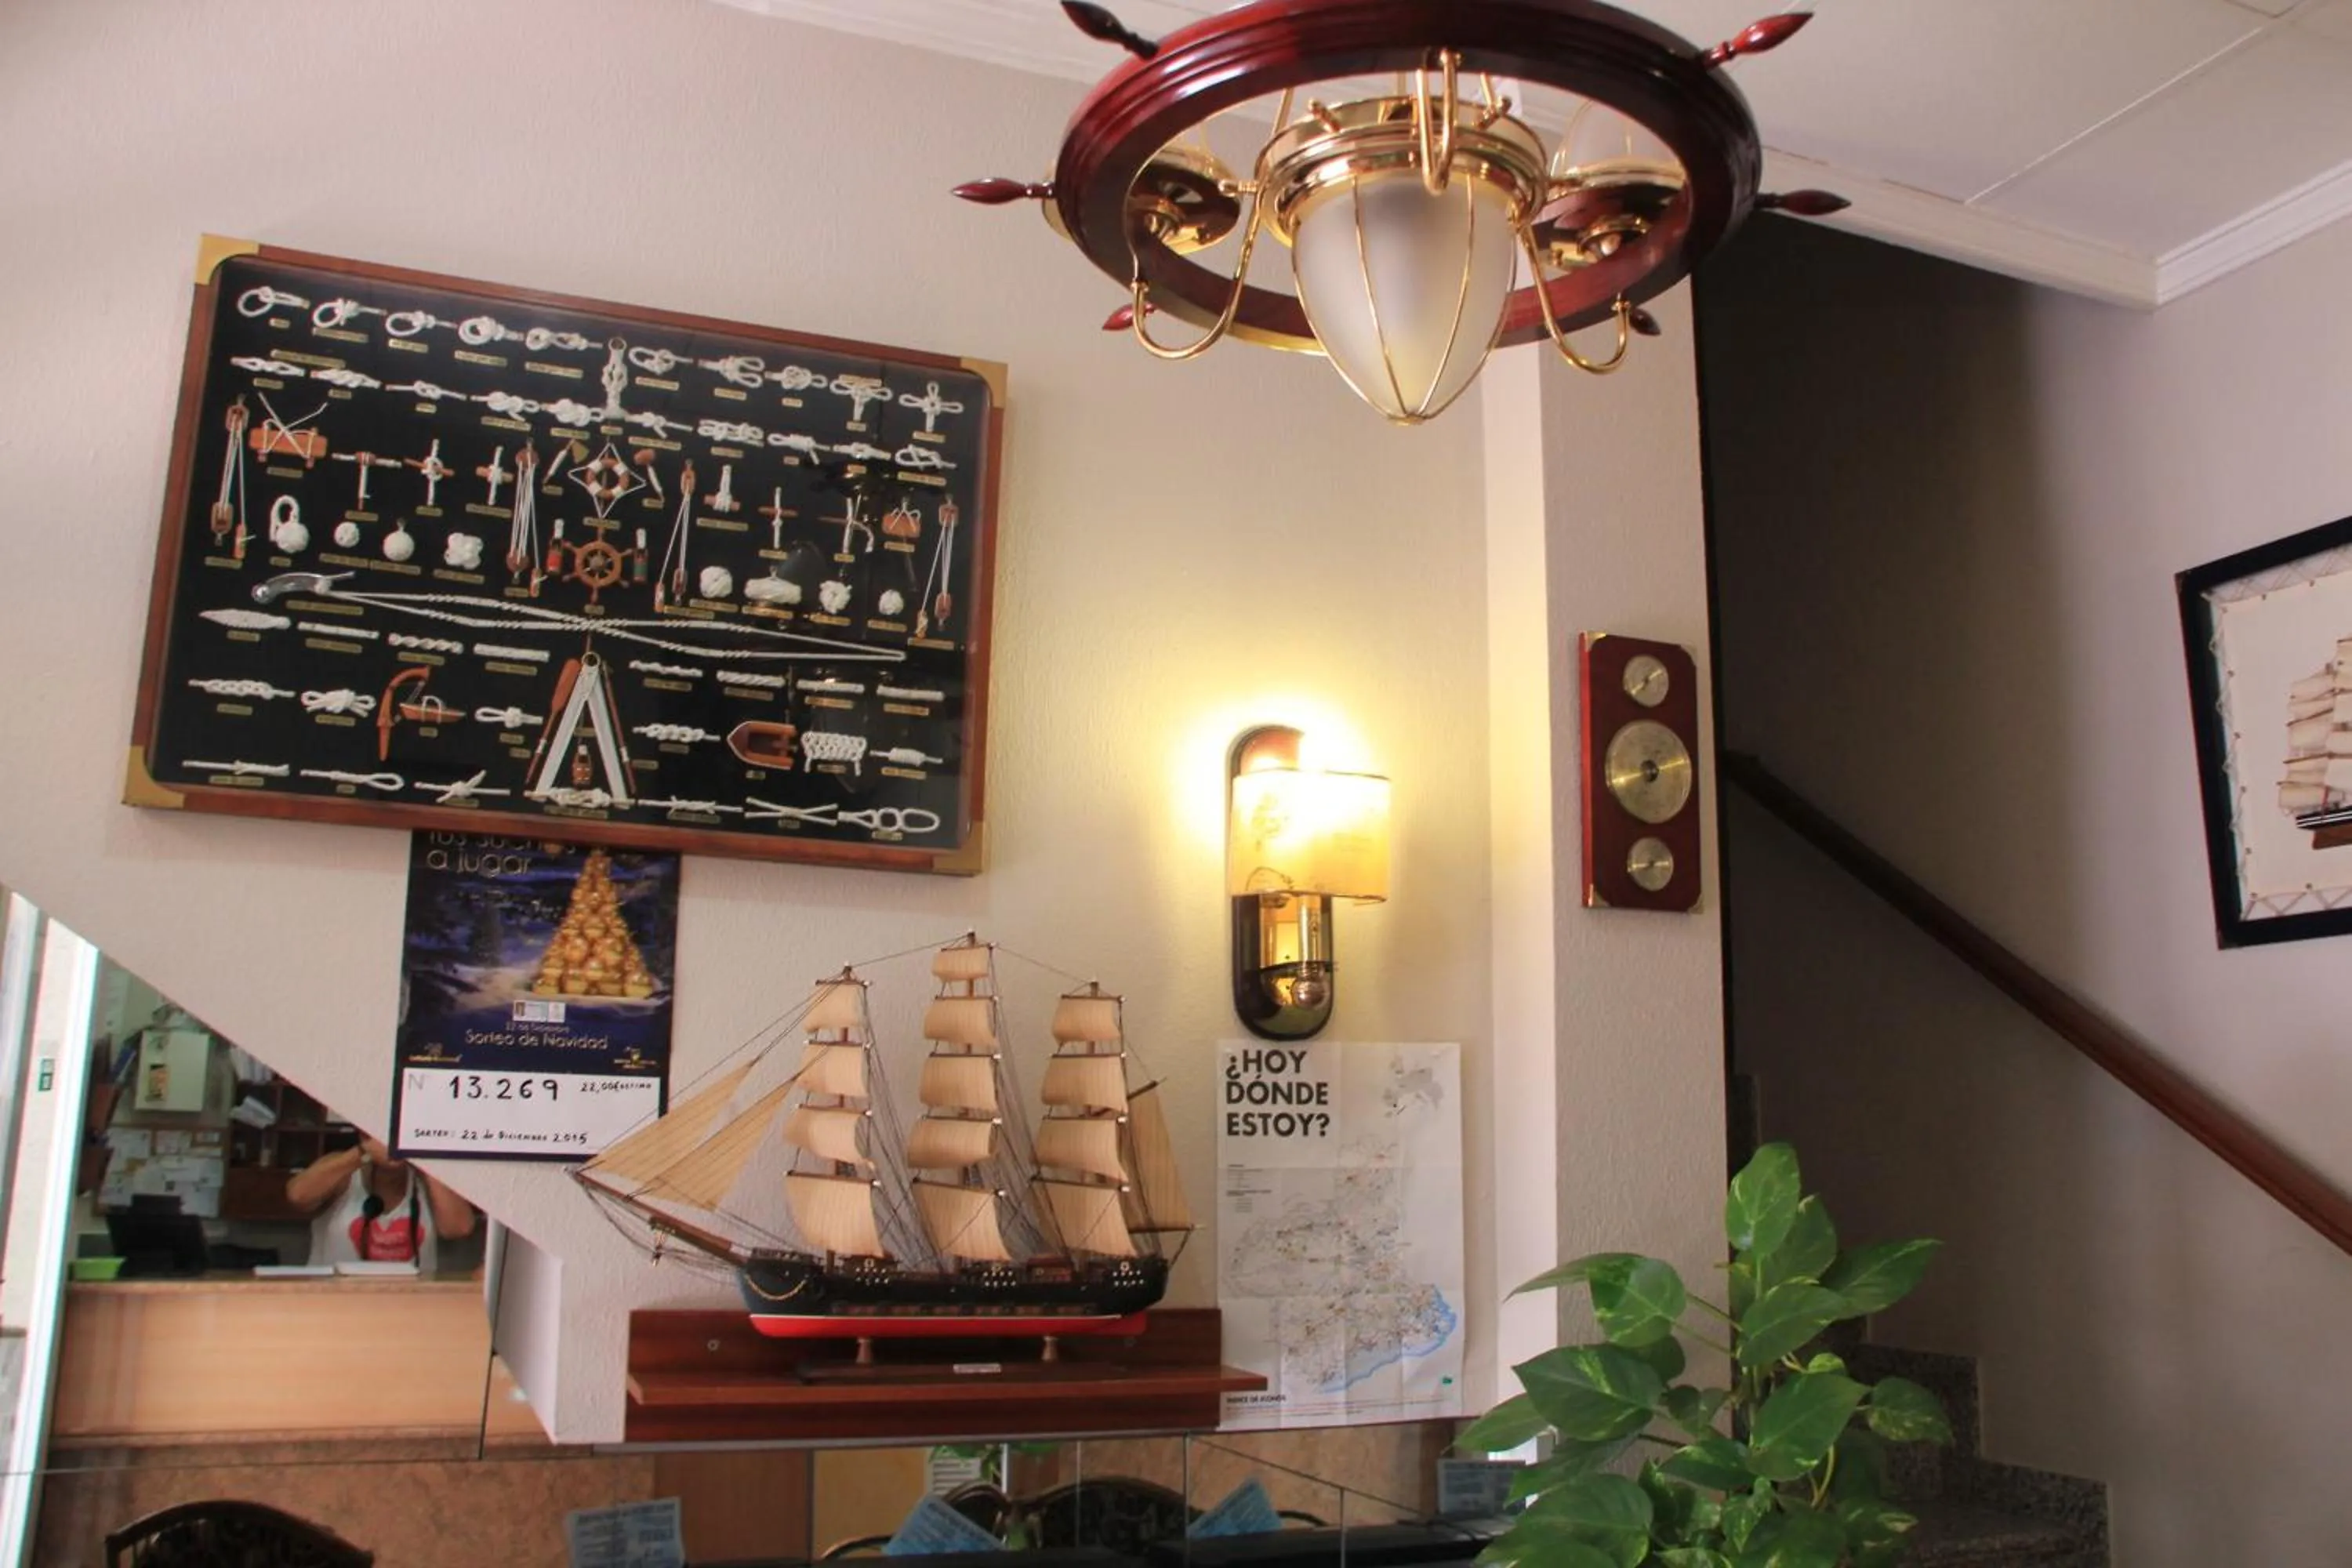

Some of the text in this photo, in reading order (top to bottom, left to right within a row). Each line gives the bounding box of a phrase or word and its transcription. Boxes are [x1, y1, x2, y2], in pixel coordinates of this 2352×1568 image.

[456, 848, 532, 878] jugar
[465, 1028, 608, 1051] Sorteo de Navidad
[1225, 1049, 1308, 1080] ¿HOY
[448, 1075, 559, 1101] 13.269
[1226, 1074, 1329, 1105] DÓNDE
[461, 1130, 477, 1140] 22
[1226, 1112, 1330, 1138] ESTOY?
